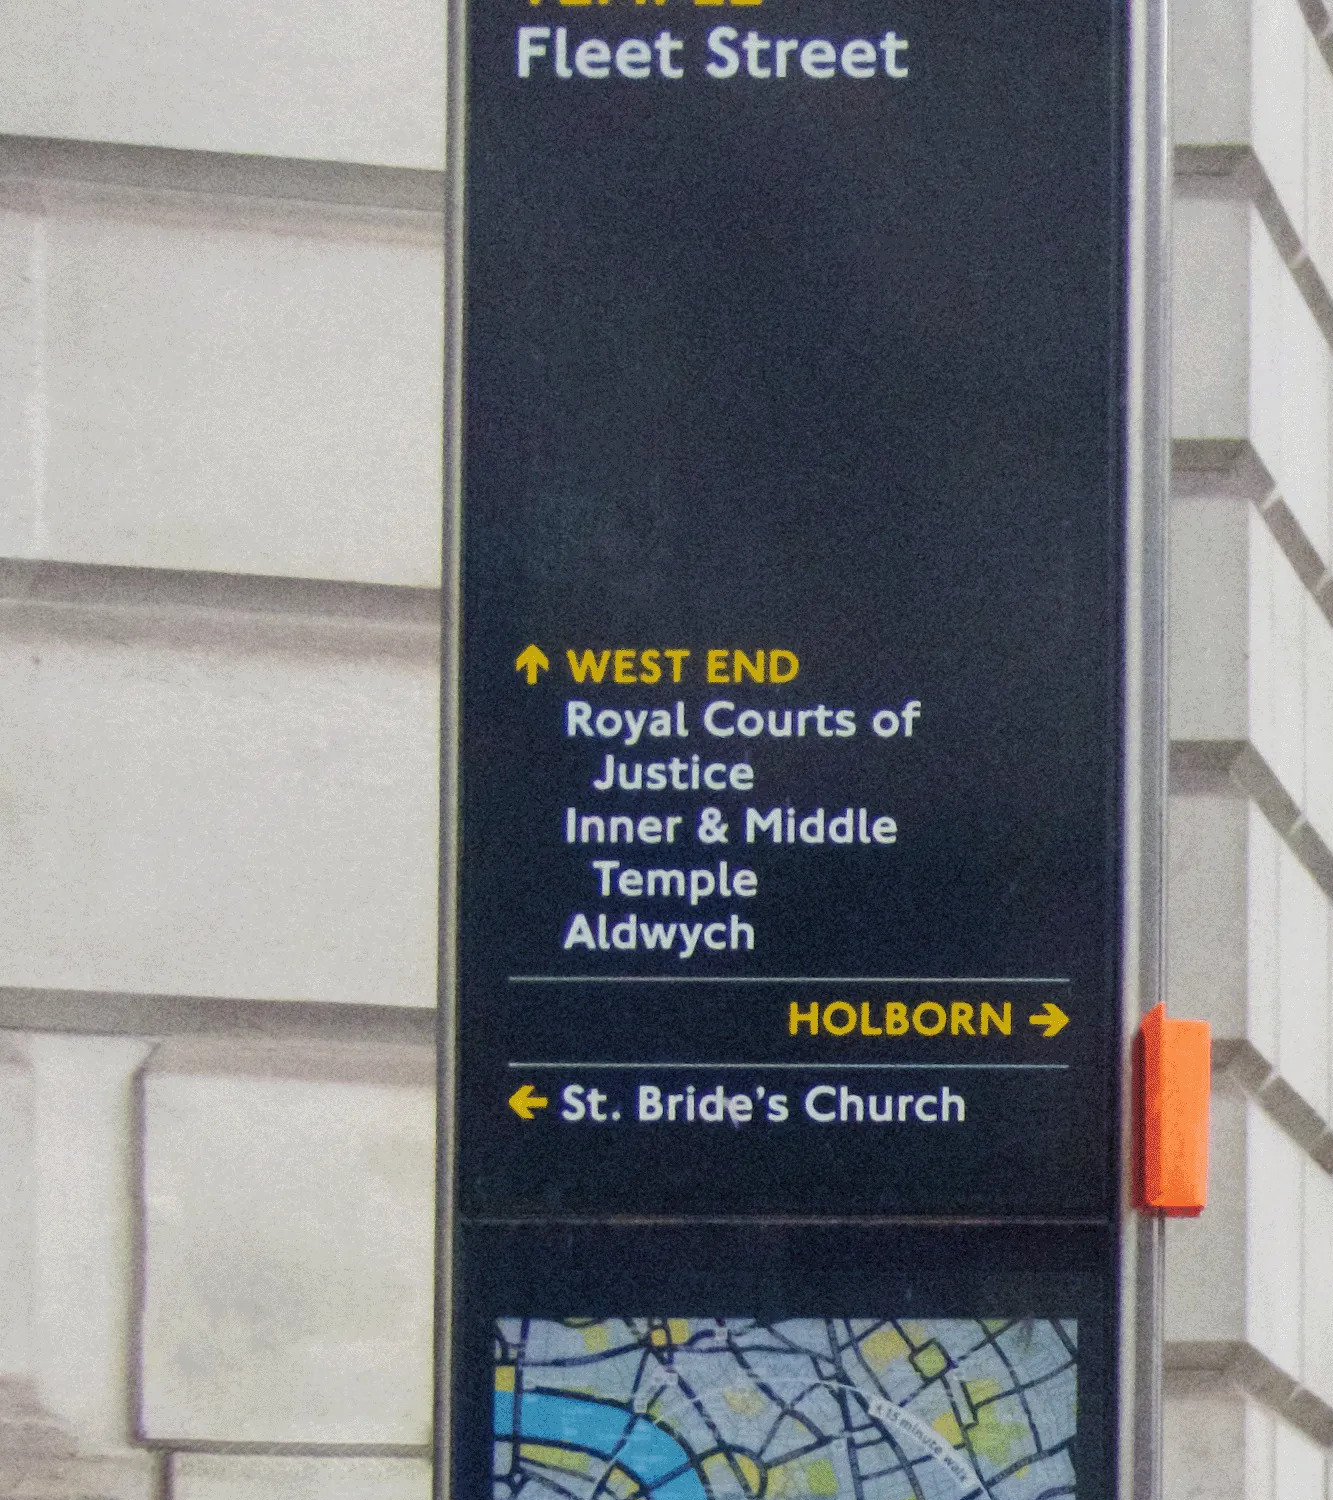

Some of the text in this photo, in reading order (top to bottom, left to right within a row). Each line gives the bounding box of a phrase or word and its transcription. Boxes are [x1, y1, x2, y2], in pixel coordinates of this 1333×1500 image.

[514, 25, 910, 79] Fleet Street
[565, 649, 800, 684] WEST END
[564, 699, 921, 746] Royal Courts of
[592, 753, 754, 791] Justice
[564, 806, 898, 845] Inner & Middle
[591, 859, 758, 906] Temple
[562, 913, 755, 959] Aldwych
[787, 1001, 1012, 1037] HOLBORN
[560, 1084, 966, 1123] St. Bride's Church
